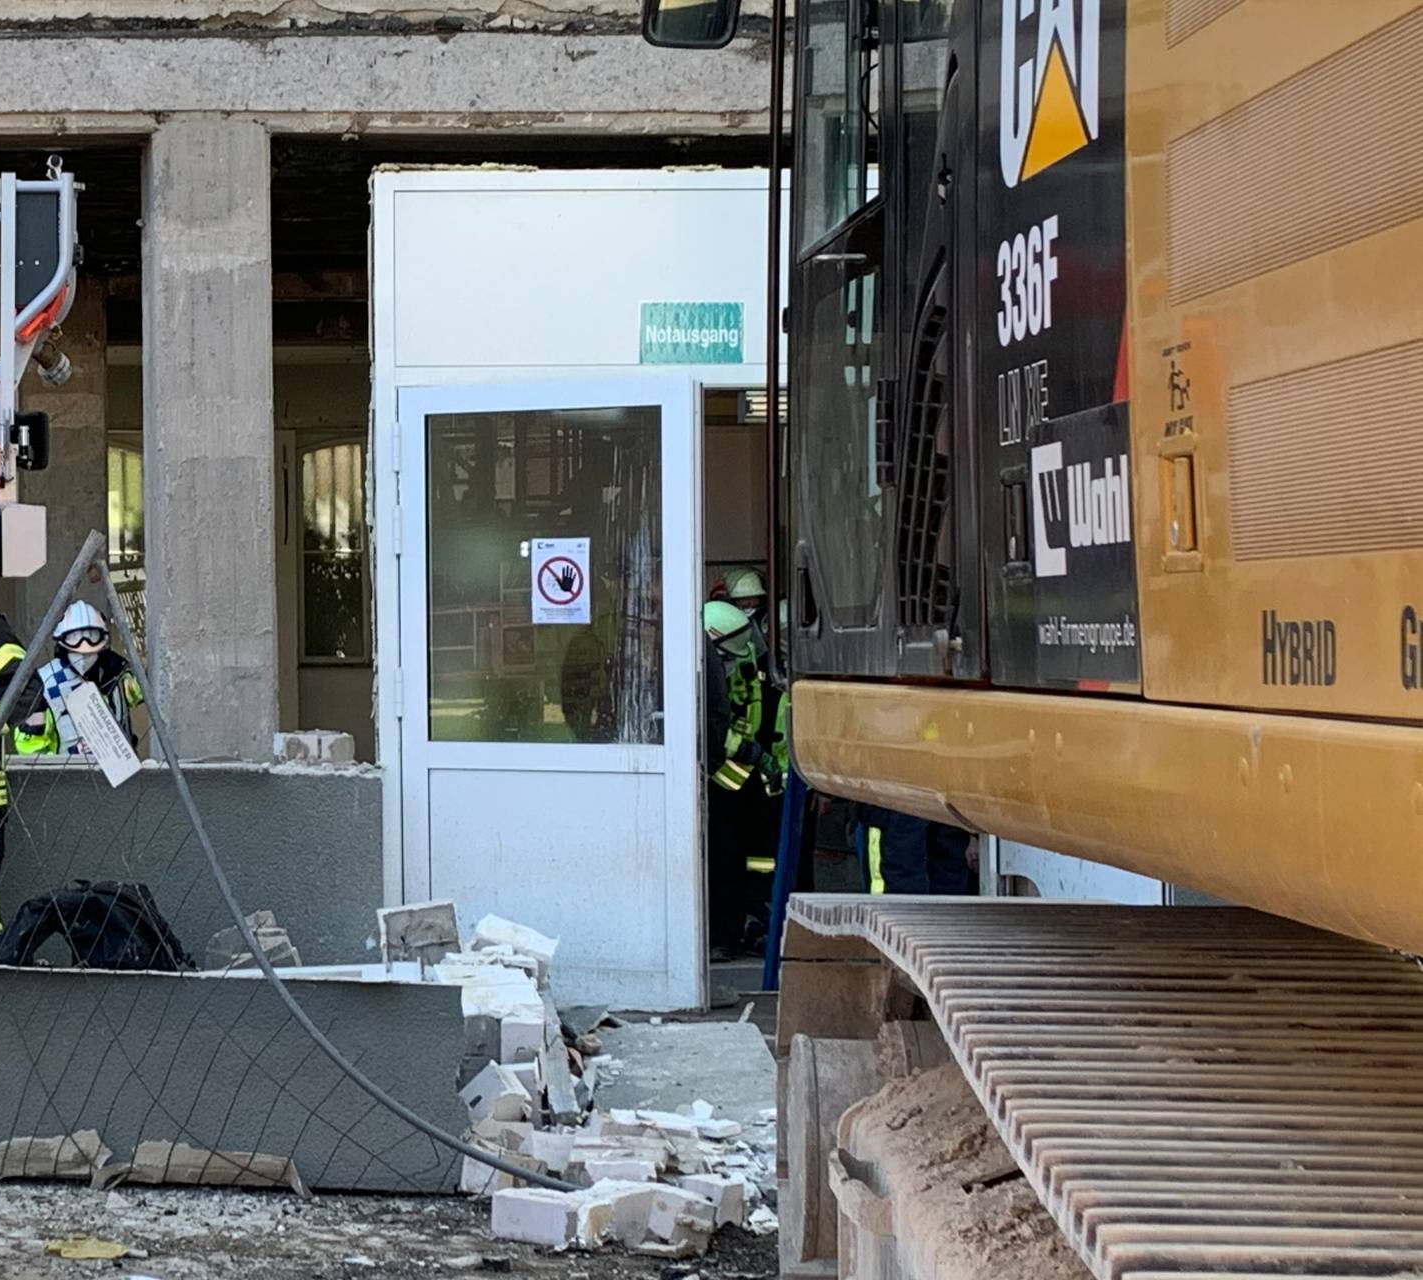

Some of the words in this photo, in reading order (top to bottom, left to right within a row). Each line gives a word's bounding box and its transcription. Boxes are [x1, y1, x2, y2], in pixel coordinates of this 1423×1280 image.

[997, 214, 1059, 347] 336F
[645, 324, 739, 348] Notausgang
[1067, 454, 1131, 548] Wahl
[1401, 605, 1423, 690] G
